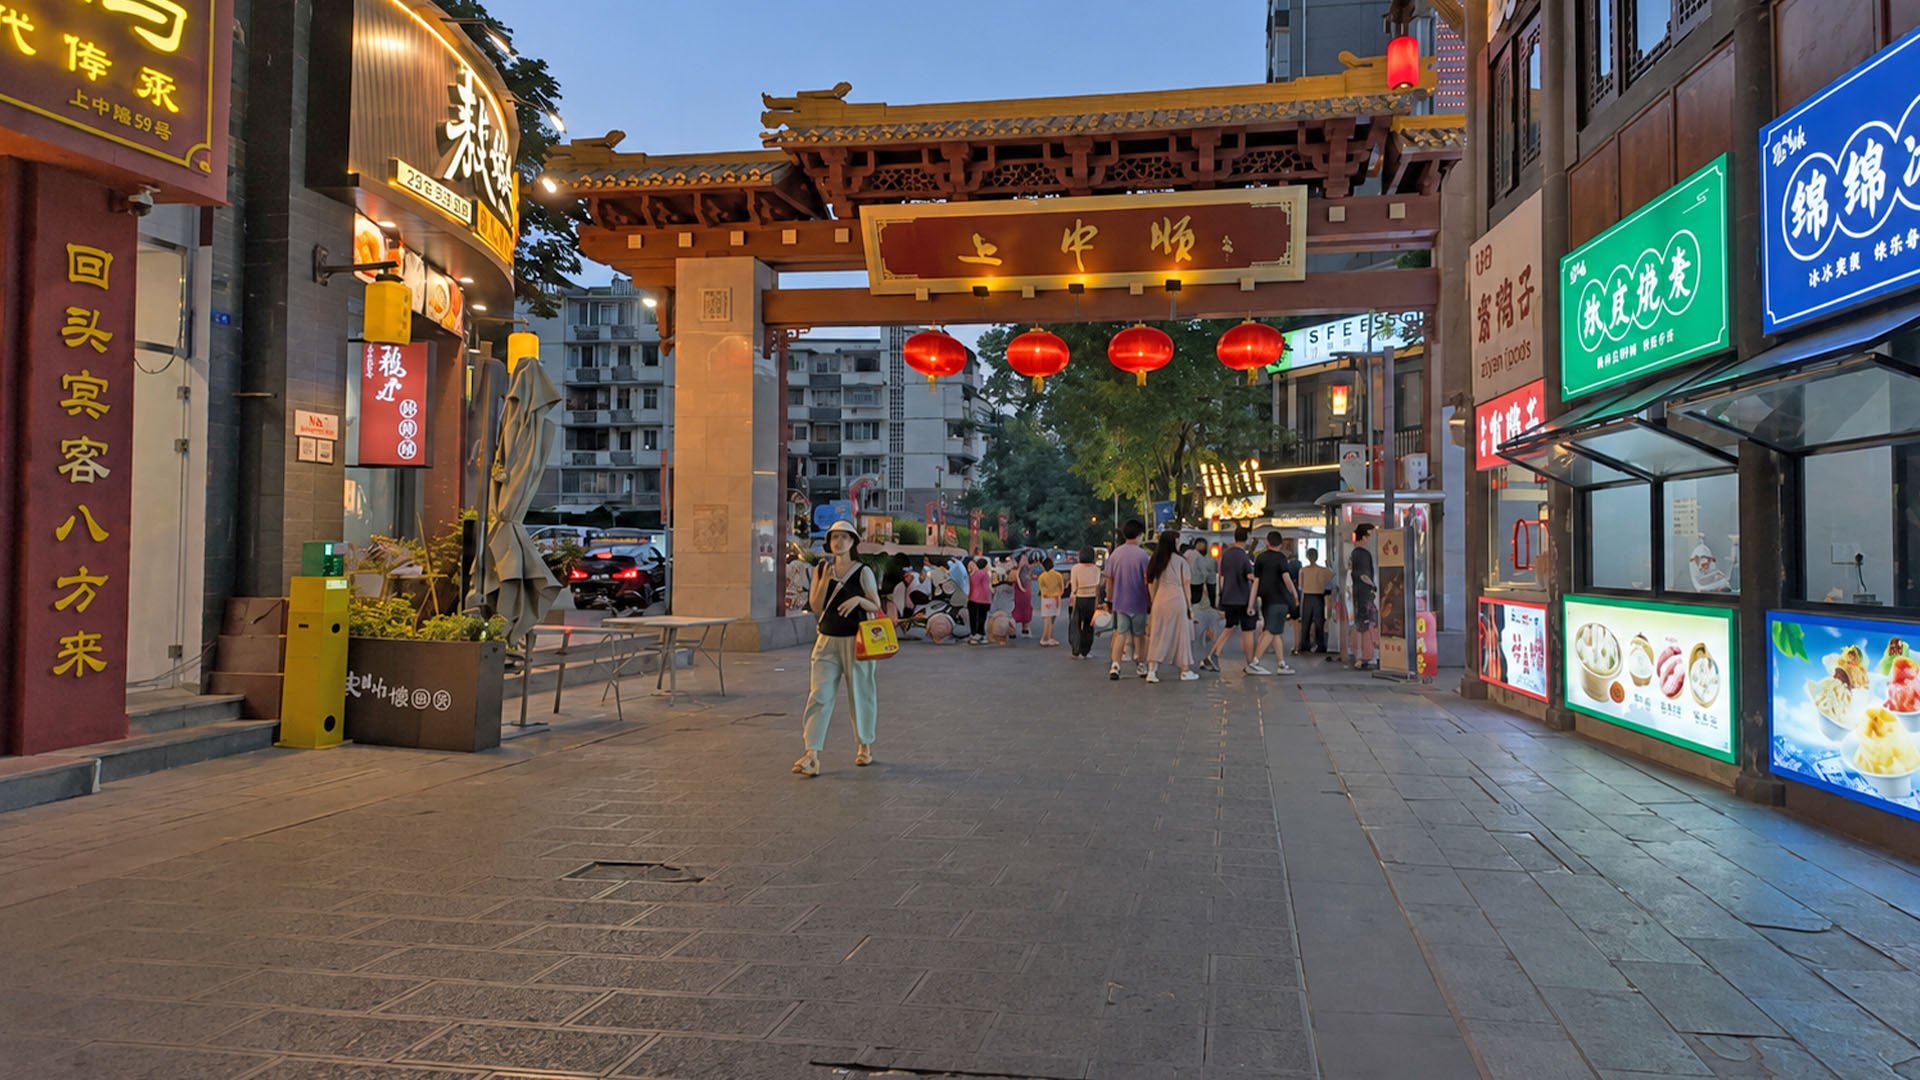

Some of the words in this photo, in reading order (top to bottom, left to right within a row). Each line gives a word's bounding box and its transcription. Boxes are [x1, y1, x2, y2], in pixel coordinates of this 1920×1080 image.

[53, 242, 114, 678] 回头宾客八方来
